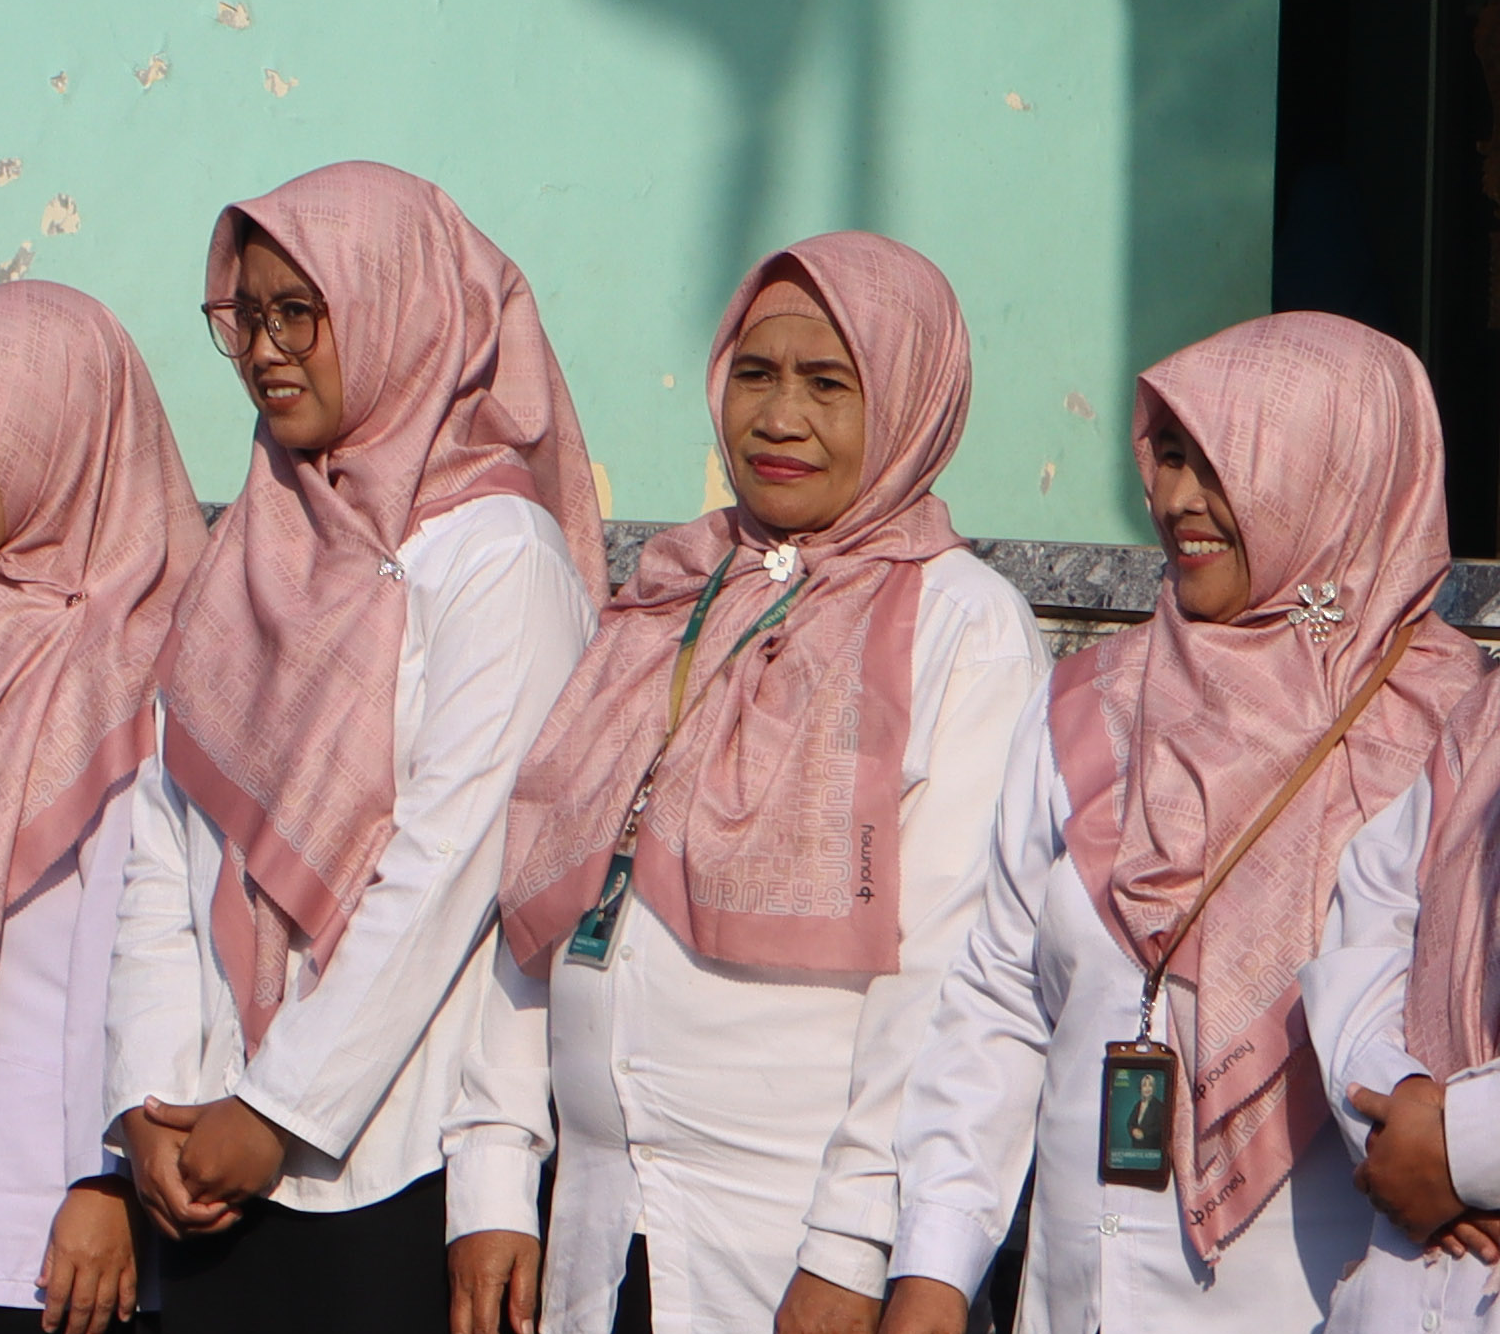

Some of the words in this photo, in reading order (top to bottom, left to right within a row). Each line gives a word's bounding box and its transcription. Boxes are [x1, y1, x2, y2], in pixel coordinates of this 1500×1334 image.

[860, 824, 876, 885] journey
[1204, 1039, 1255, 1088] journey
[1207, 1170, 1246, 1218] journey
